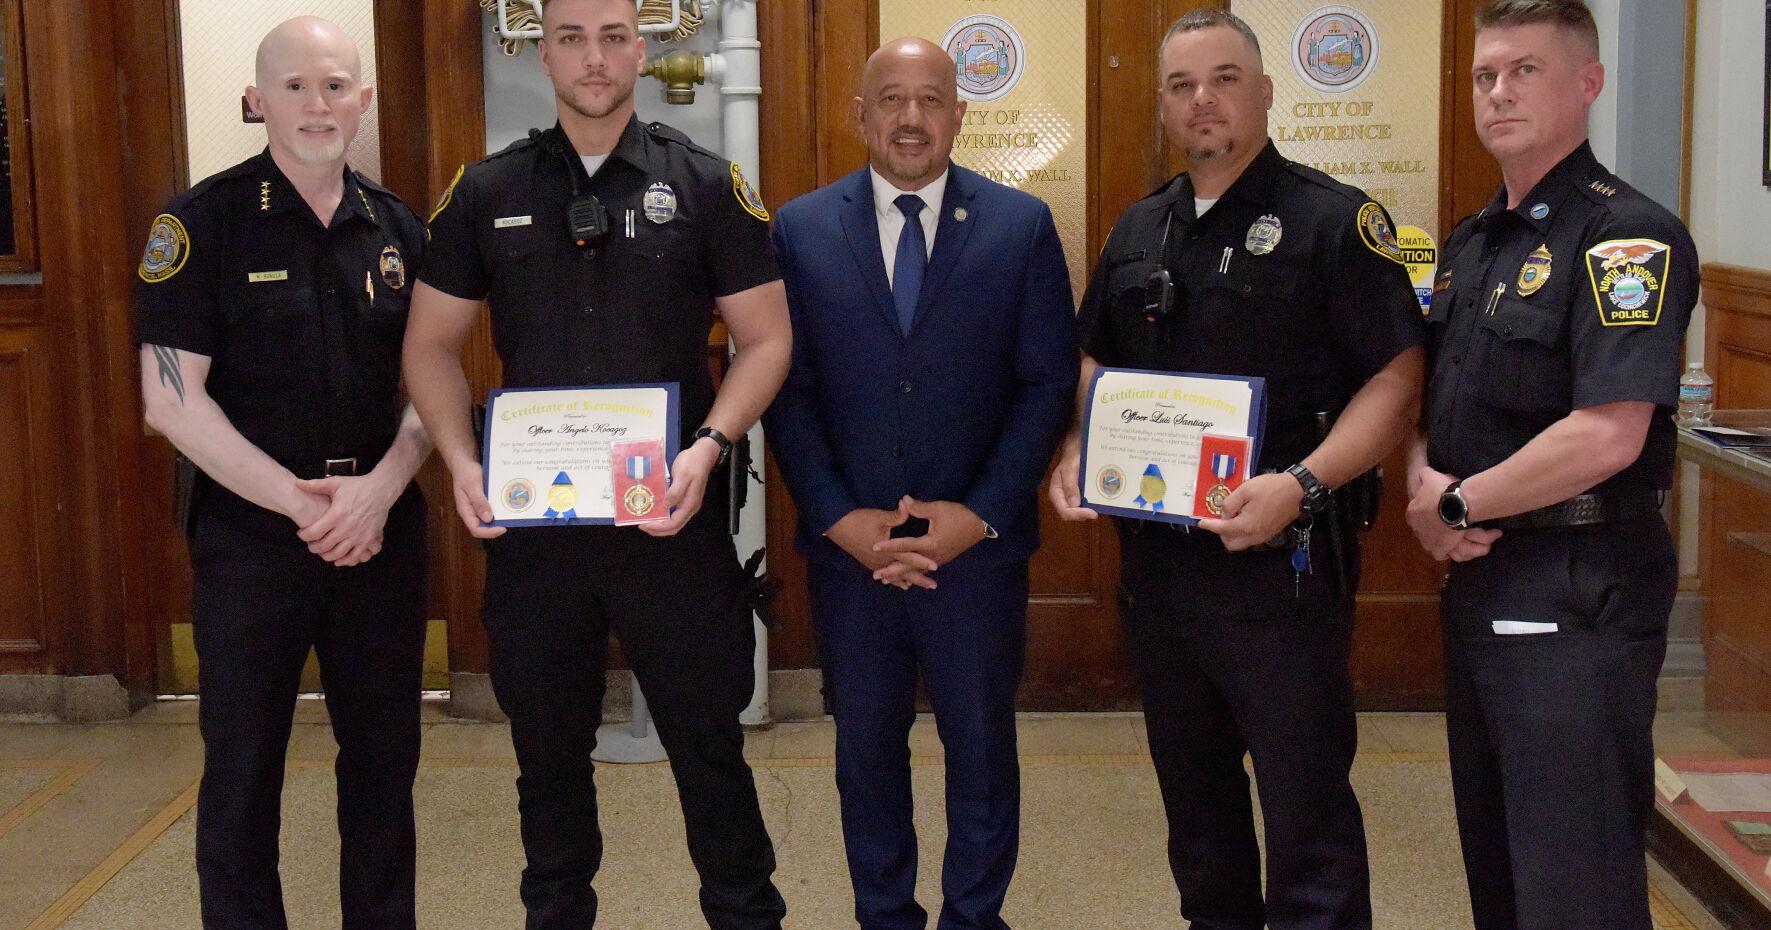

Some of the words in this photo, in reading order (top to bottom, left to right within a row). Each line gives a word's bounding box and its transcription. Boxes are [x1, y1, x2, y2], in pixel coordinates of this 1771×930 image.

[964, 109, 989, 125] TY
[996, 109, 1019, 125] OF
[1292, 101, 1343, 118] CITY
[1345, 101, 1374, 117] OF
[953, 132, 1038, 149] WRENCE
[1278, 124, 1392, 142] LAWRENCE
[1378, 160, 1426, 173] WALL
[1025, 170, 1071, 182] WALL
[1397, 237, 1430, 246] OMATIC
[1402, 251, 1433, 262] TION
[1600, 267, 1620, 292] NORTH
[1626, 264, 1659, 291] ANDOVER
[1414, 288, 1432, 297] ITCH
[1611, 310, 1650, 320] POLICE
[1100, 389, 1153, 405] Certificate
[1158, 389, 1168, 399] of
[1173, 388, 1237, 416] Recognition
[500, 404, 561, 423] Certificate
[566, 401, 577, 410] of
[583, 400, 654, 417] Recognition
[1121, 409, 1148, 423] Officer
[1149, 411, 1171, 423] Luis
[1173, 414, 1213, 431] Santiago
[528, 425, 553, 437] Officer
[557, 424, 589, 437] Angelo
